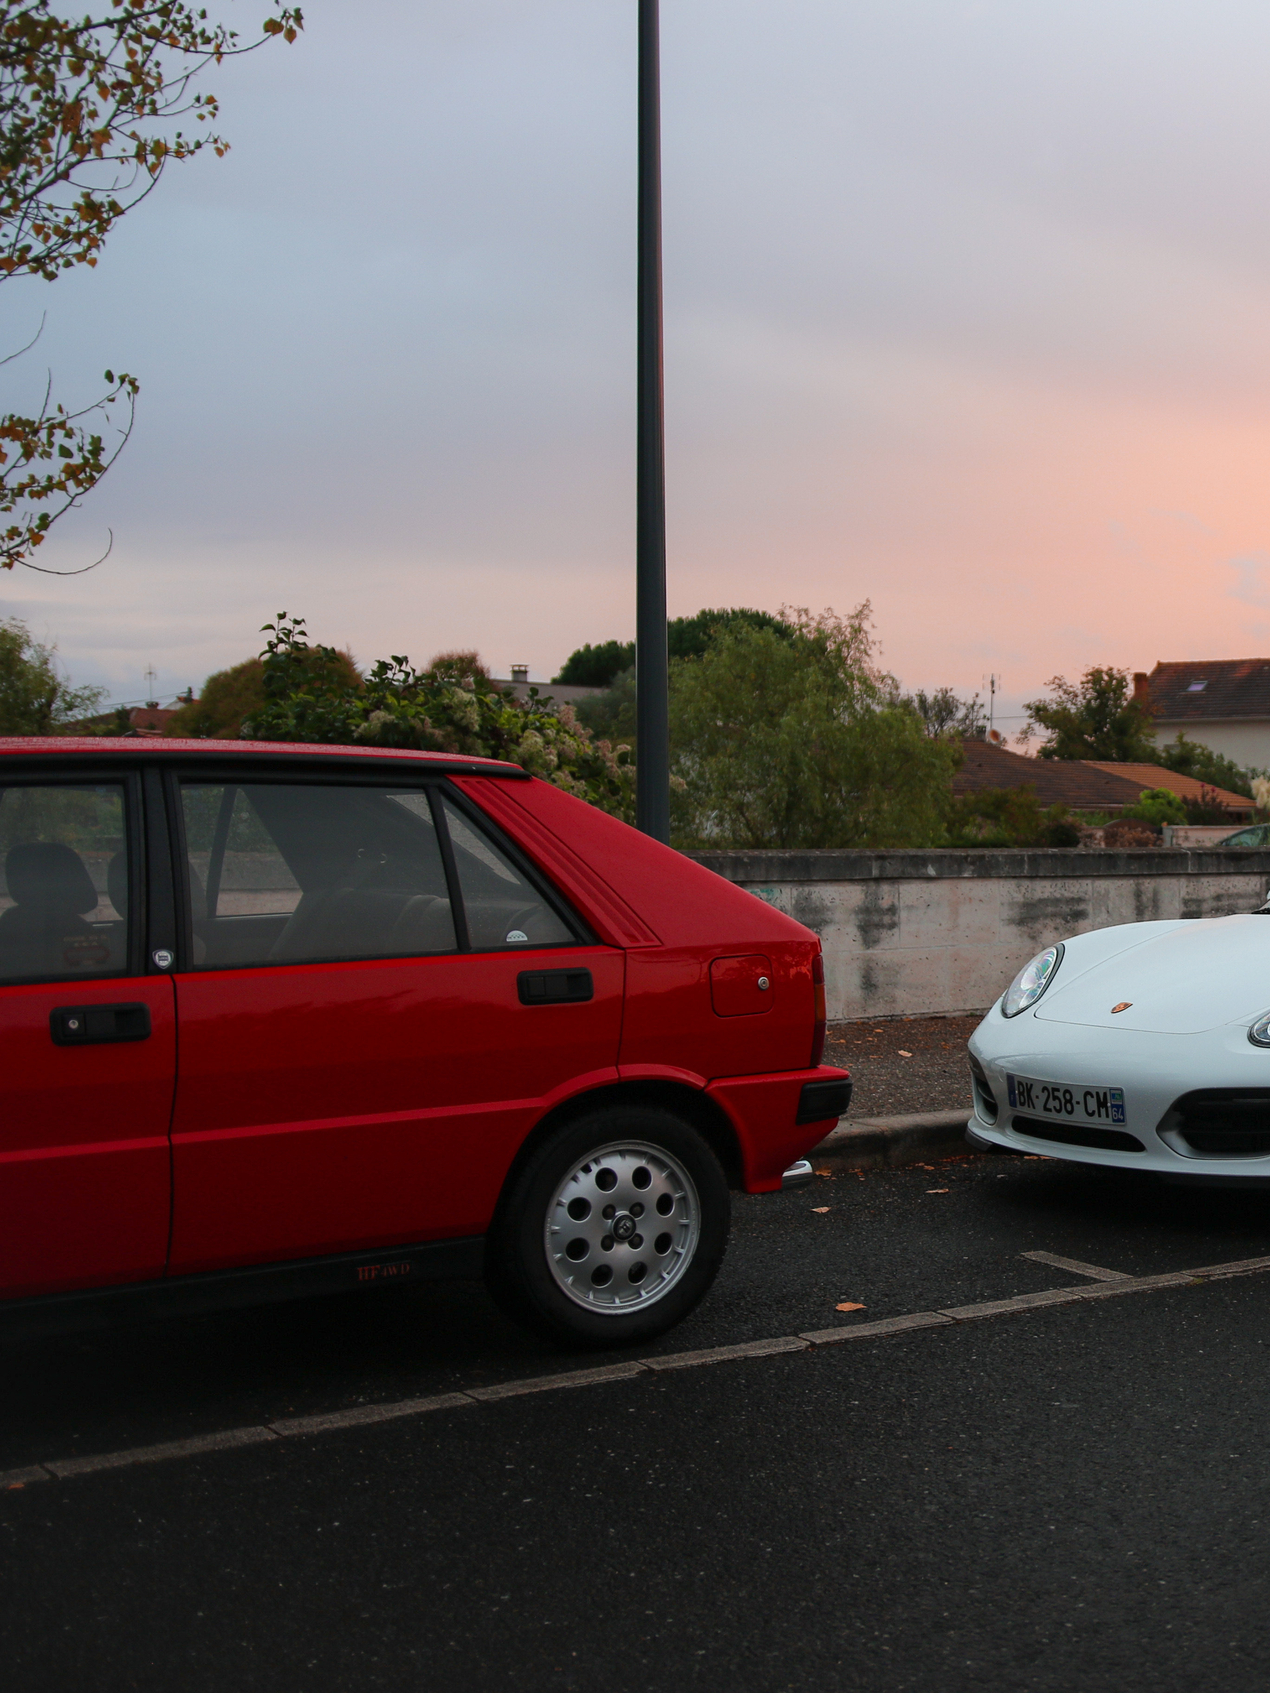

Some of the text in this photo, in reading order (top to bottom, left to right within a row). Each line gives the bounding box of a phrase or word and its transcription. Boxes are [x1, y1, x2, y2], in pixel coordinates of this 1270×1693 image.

[1017, 1080, 1110, 1118] BK-258-CM
[1111, 1107, 1124, 1120] 64
[358, 1266, 380, 1280] HF
